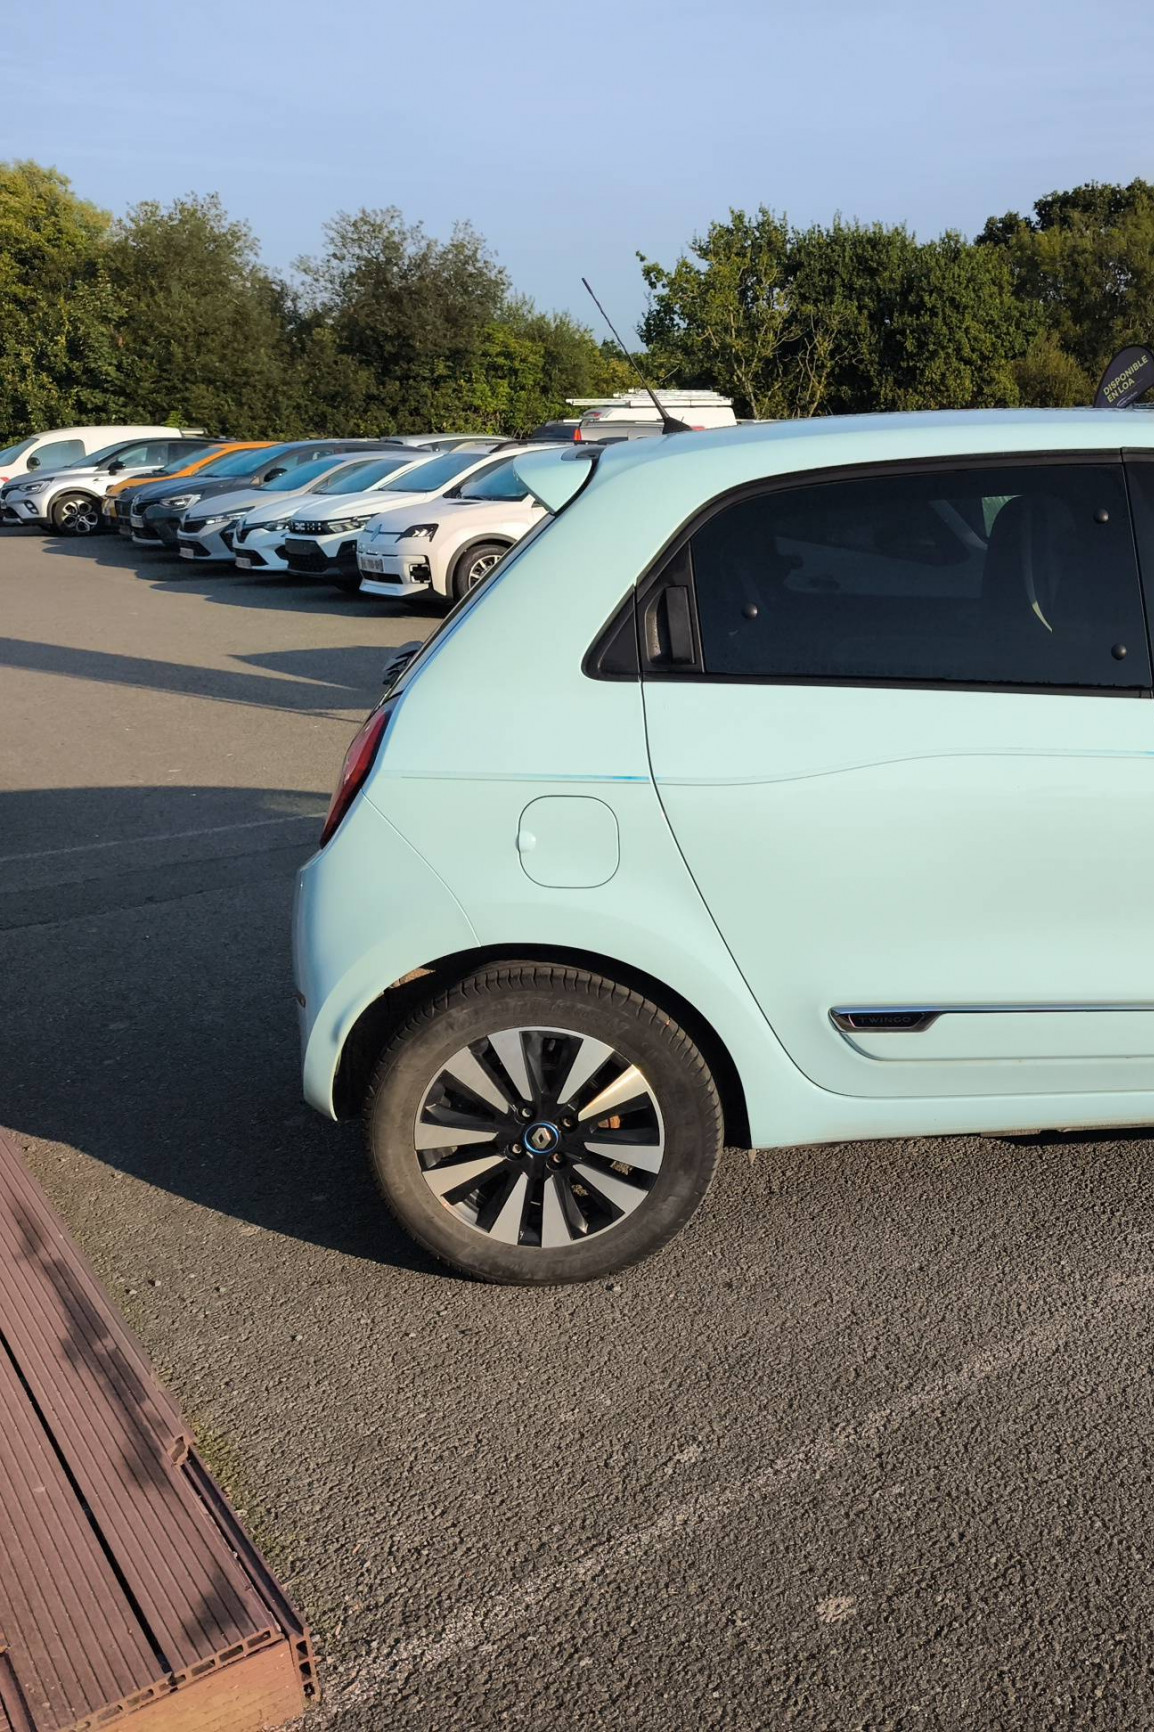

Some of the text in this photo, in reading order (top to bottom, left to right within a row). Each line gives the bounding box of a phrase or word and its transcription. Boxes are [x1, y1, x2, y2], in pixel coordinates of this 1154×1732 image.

[1103, 355, 1148, 395] DISPONIBLE
[1107, 390, 1119, 403] EN
[1118, 378, 1135, 393] LOA
[858, 1016, 912, 1024] TWINGO
